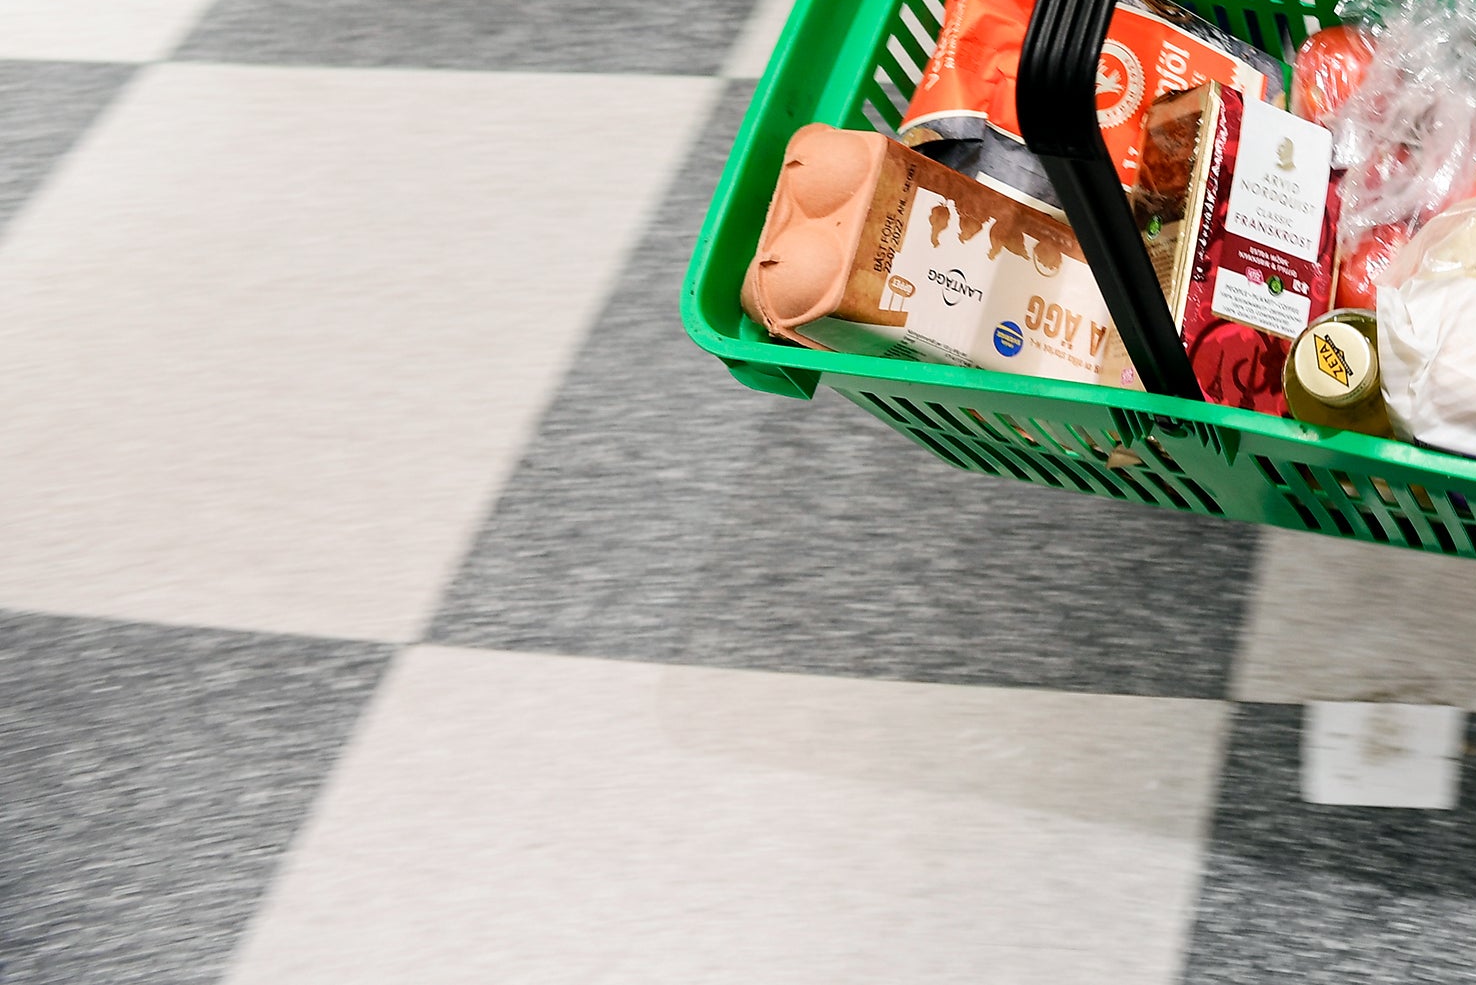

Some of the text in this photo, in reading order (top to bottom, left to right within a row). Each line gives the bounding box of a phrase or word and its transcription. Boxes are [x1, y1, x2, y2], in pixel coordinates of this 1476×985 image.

[1240, 178, 1316, 214] NORDQUIST
[1262, 174, 1300, 195] ARVID
[1234, 211, 1313, 250] FRANSKROST
[927, 268, 983, 302] LANTÄGG
[1025, 295, 1082, 350] ÄGG
[1320, 343, 1344, 377] ZETA
